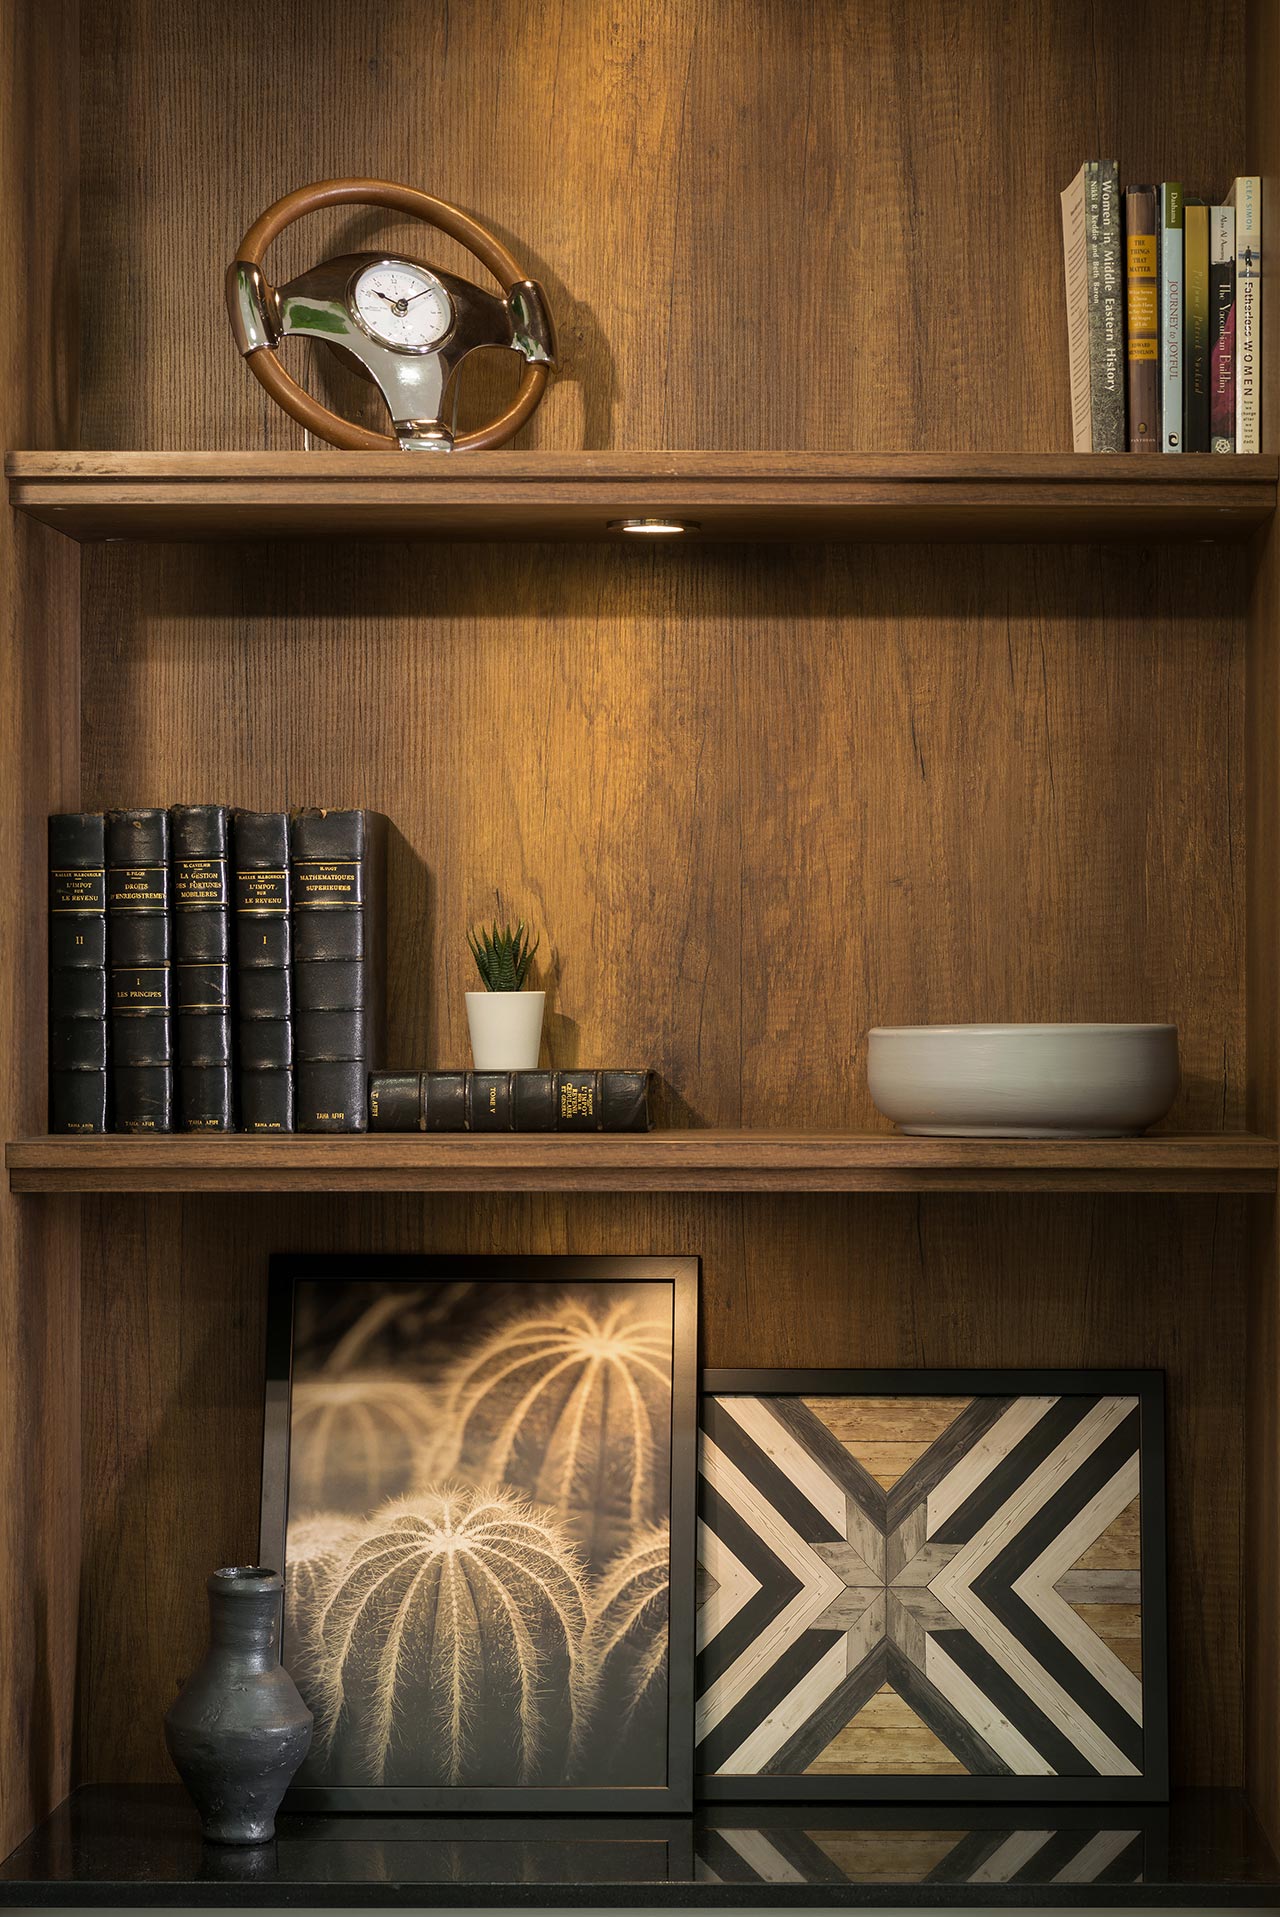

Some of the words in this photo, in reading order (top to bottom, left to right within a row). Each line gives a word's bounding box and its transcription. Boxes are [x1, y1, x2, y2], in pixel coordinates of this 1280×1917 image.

[1102, 180, 1112, 226] Women
[1091, 215, 1099, 241] Keddie
[1103, 232, 1114, 244] in
[1104, 251, 1115, 292] Middle
[1220, 284, 1231, 300] The
[1105, 298, 1115, 341] Eastern
[1168, 280, 1178, 330] JOURNEY
[1244, 282, 1254, 336] Fatherless
[1220, 304, 1231, 350] Yacoubian
[1105, 348, 1116, 392] History
[1168, 340, 1178, 380] JOYFUL
[1217, 356, 1231, 394] Building
[1244, 340, 1253, 396] WOMEN
